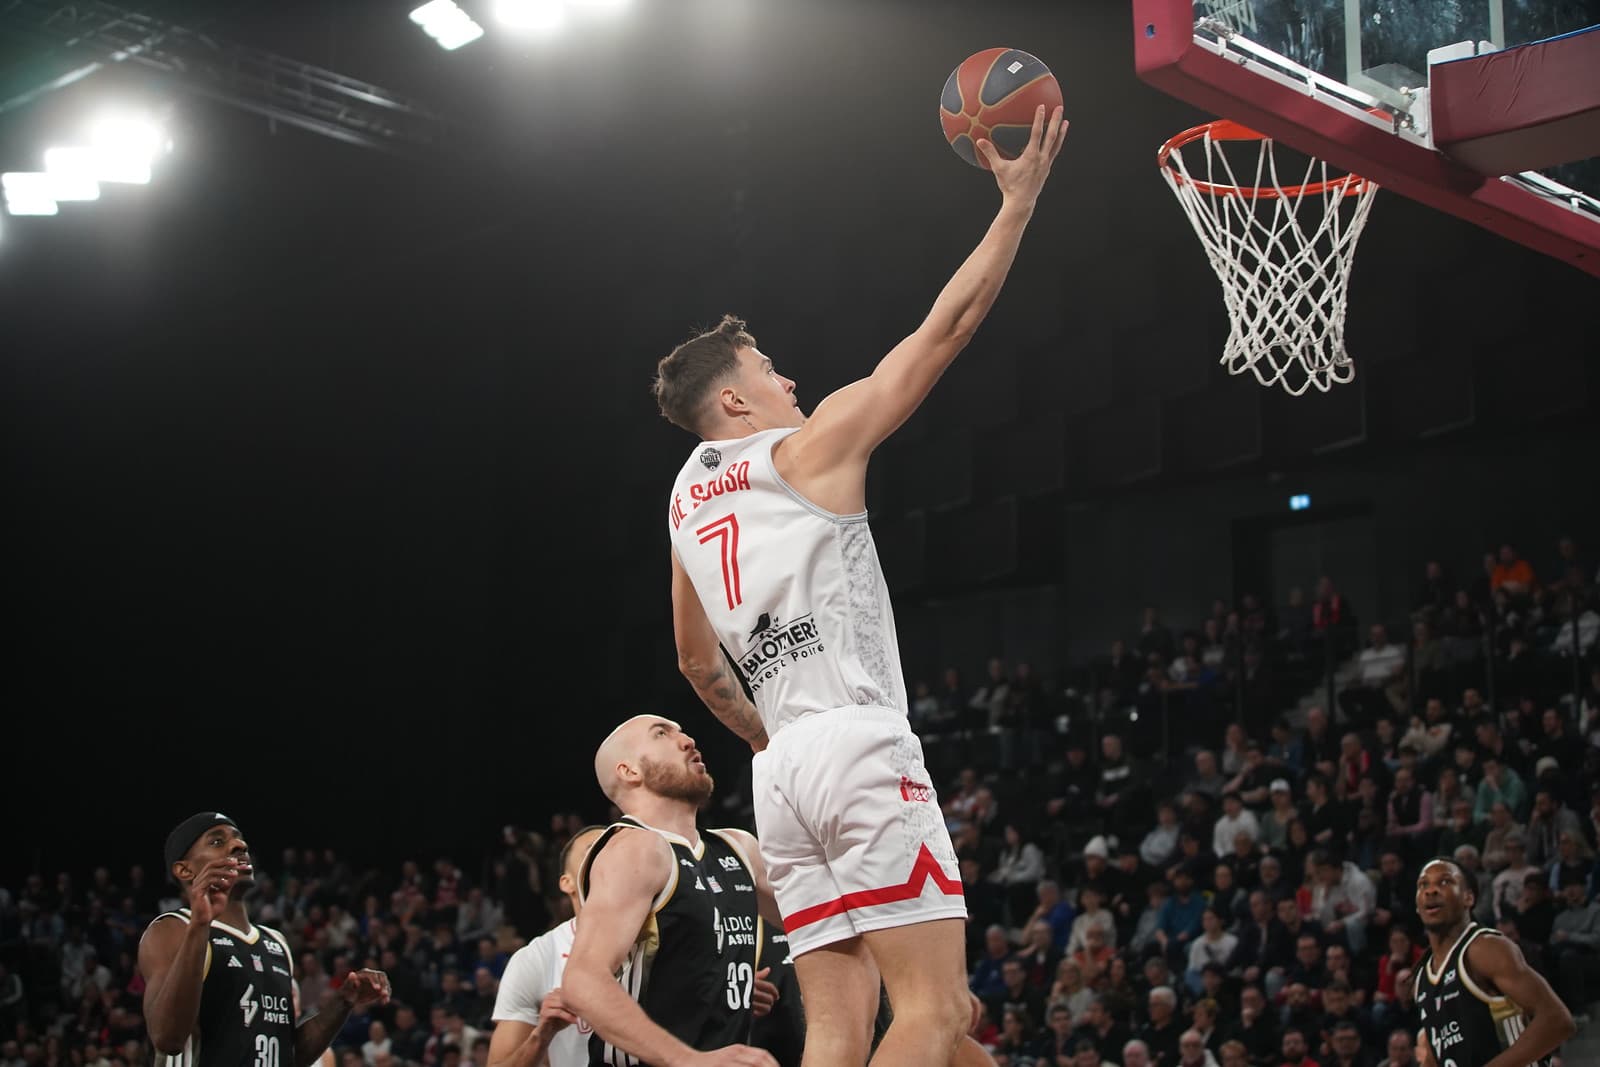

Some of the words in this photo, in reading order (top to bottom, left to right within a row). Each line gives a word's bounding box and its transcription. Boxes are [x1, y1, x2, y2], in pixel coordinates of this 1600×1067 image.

[671, 492, 688, 531] DE
[690, 461, 751, 509] SOUSA
[696, 512, 742, 611] 7
[723, 916, 753, 932] LDLC
[726, 962, 753, 1010] 32
[255, 1034, 280, 1067] 30
